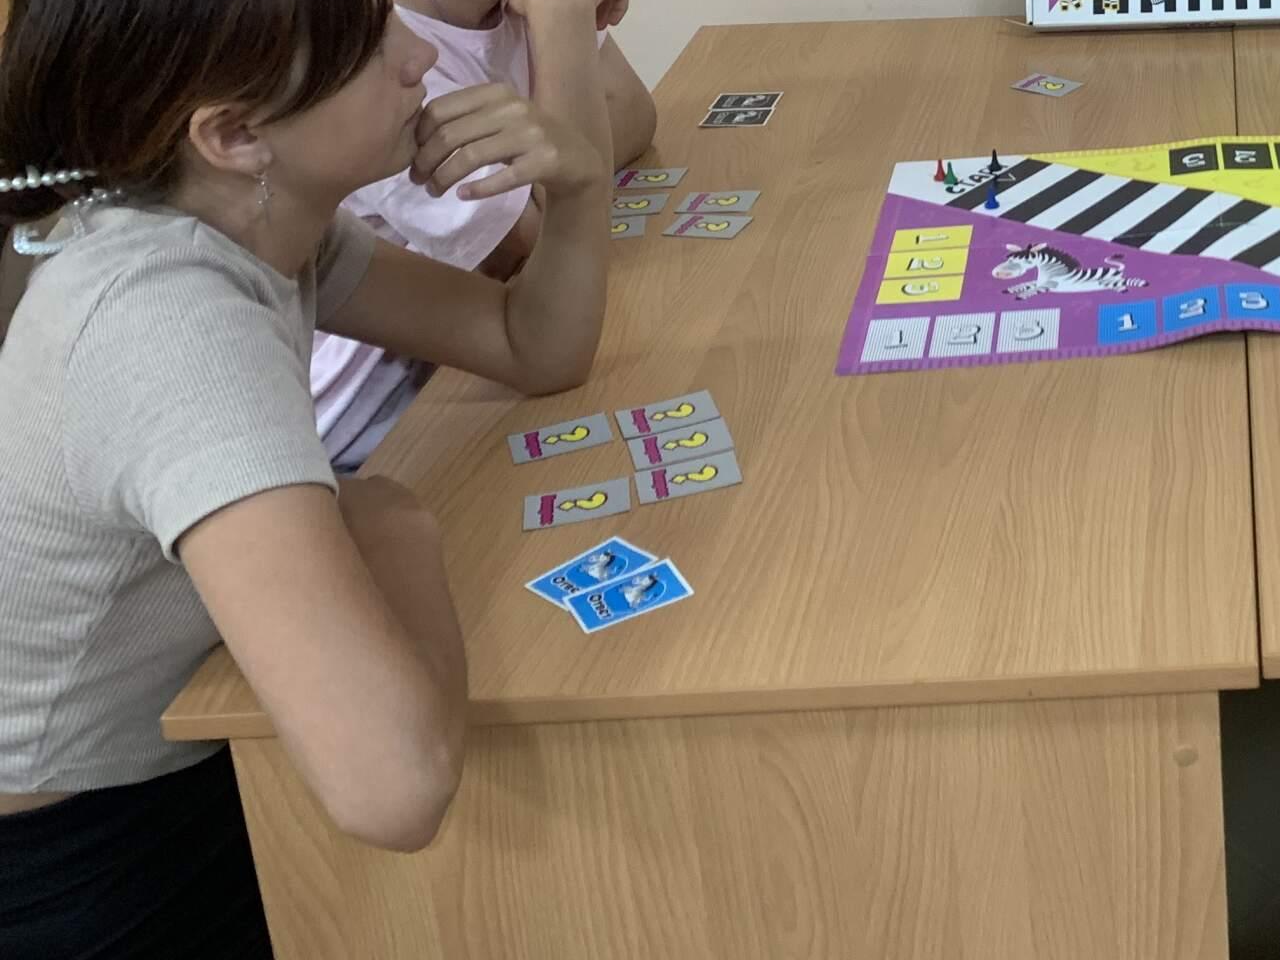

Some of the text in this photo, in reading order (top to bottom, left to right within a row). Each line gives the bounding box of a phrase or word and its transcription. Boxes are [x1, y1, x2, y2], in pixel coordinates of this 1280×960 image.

[945, 162, 1009, 194] СТАР
[1177, 297, 1208, 320] 2
[1238, 290, 1270, 311] 3
[1117, 313, 1139, 332] 1
[552, 576, 580, 594] Отве
